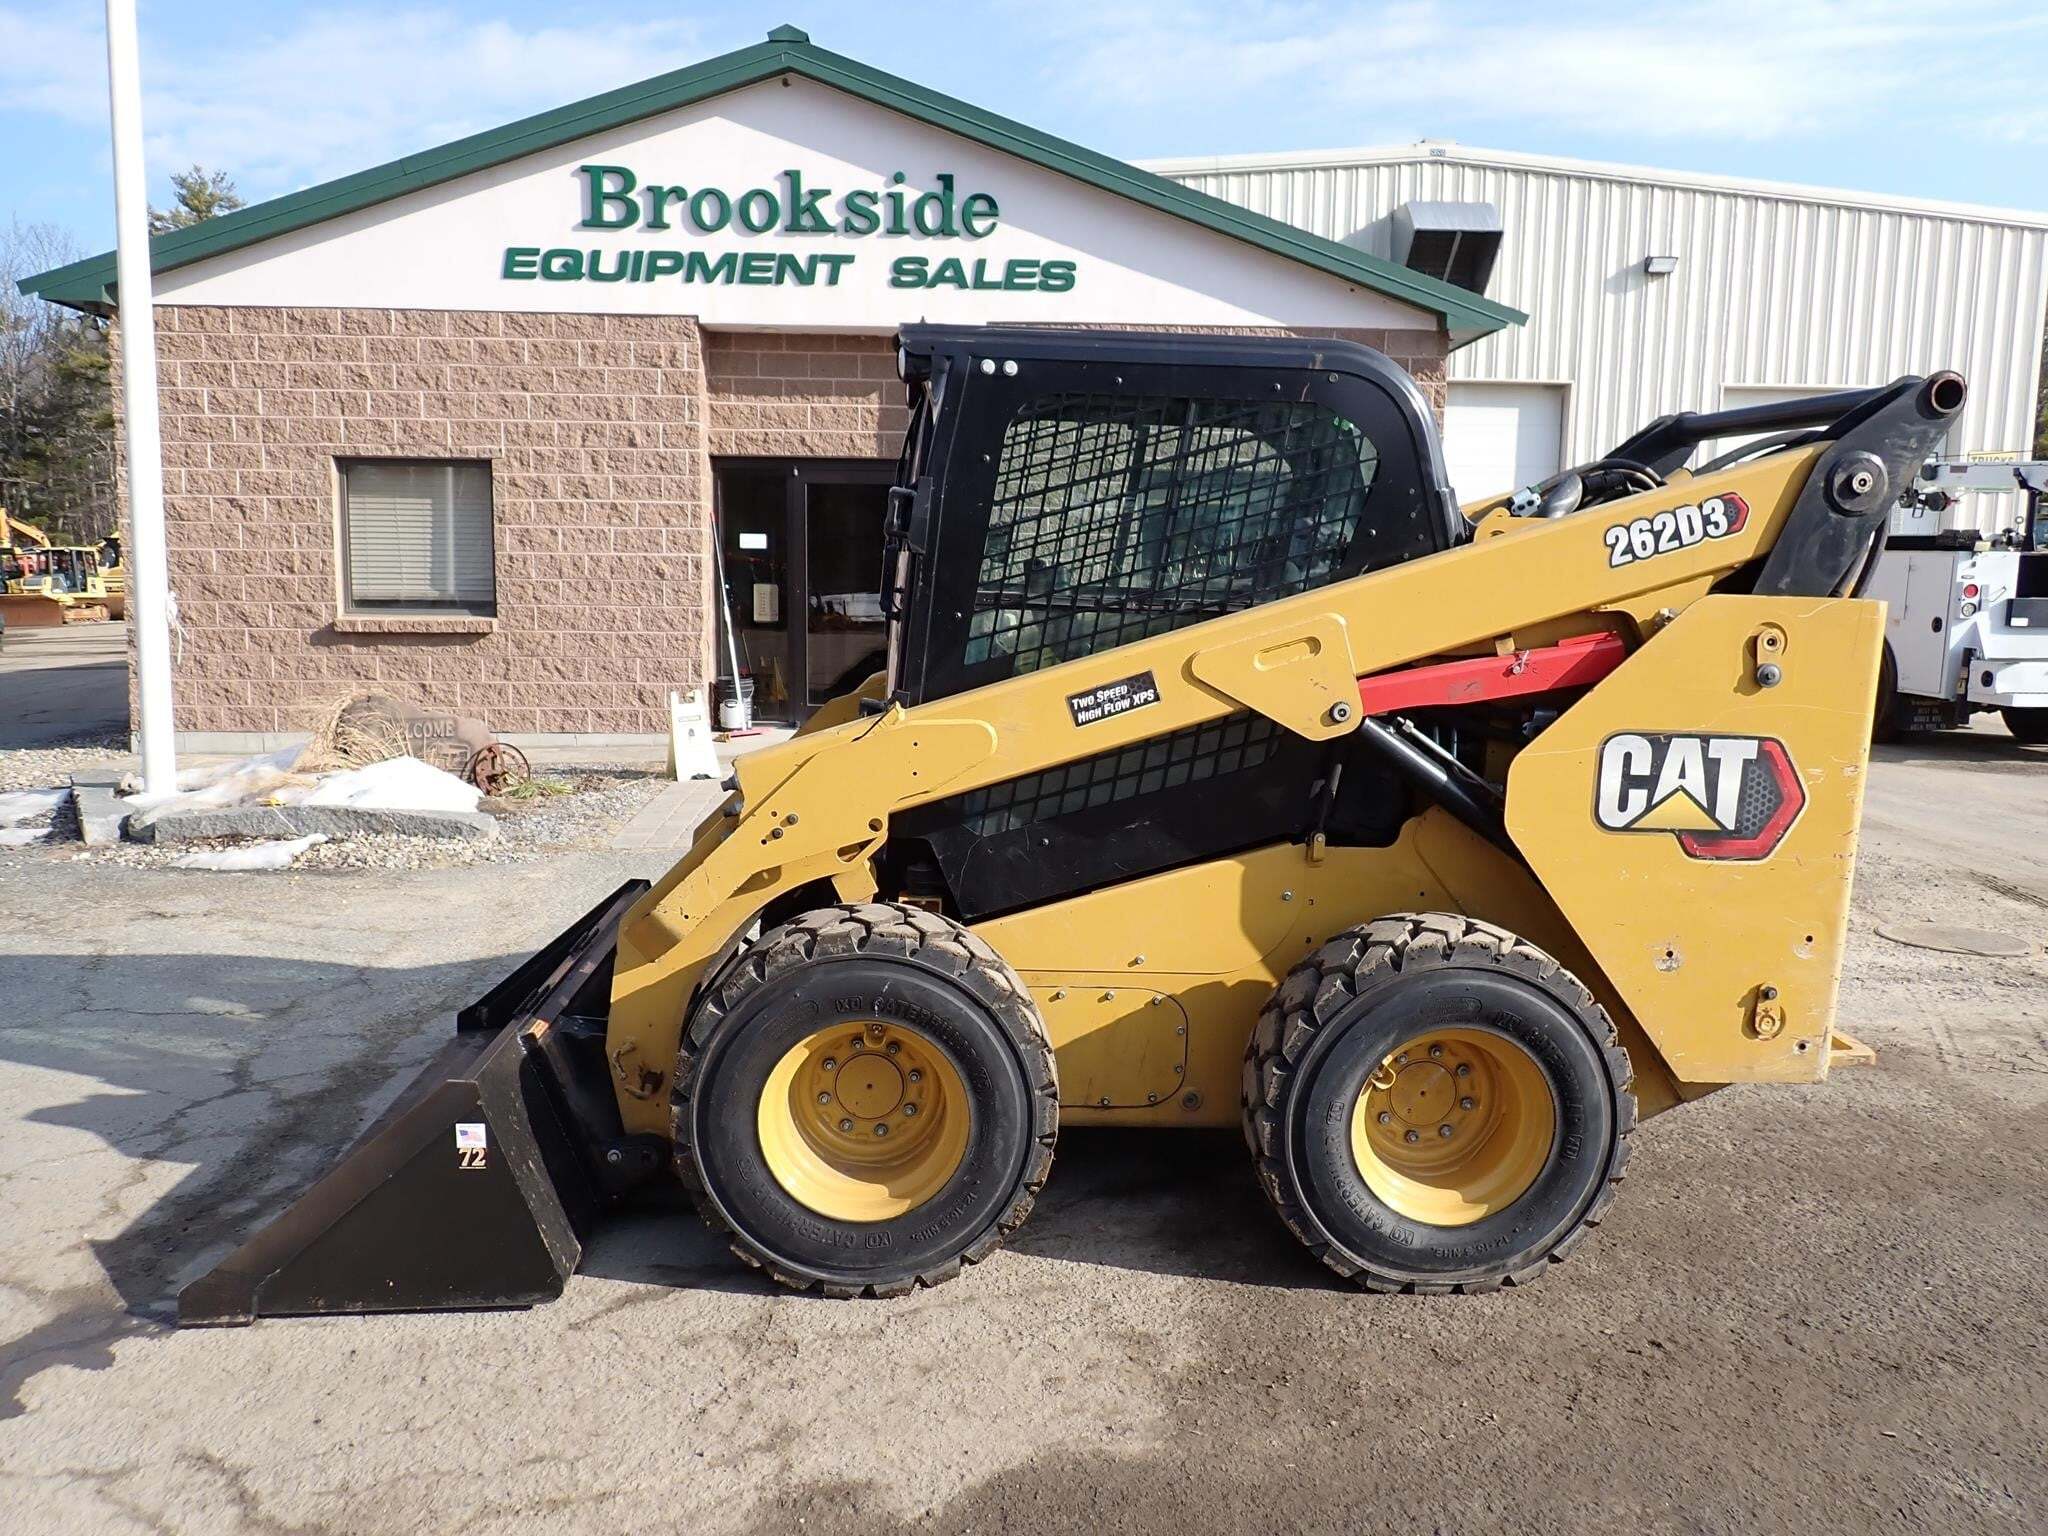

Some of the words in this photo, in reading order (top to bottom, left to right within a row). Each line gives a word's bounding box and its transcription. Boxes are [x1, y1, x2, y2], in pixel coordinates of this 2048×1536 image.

[580, 165, 999, 239] Brookside
[503, 247, 855, 286] EQUIPMENT
[890, 257, 1077, 292] SALES
[1605, 498, 1729, 567] 262D3
[1072, 696, 1095, 710] TWO
[1096, 685, 1128, 701] SPEED
[1077, 706, 1102, 723] HIGH
[1104, 697, 1131, 716] FLOW
[1132, 689, 1155, 706] XPS
[394, 719, 456, 738] LCOME
[1599, 734, 1759, 831] CAT
[458, 1148, 487, 1168] 72
